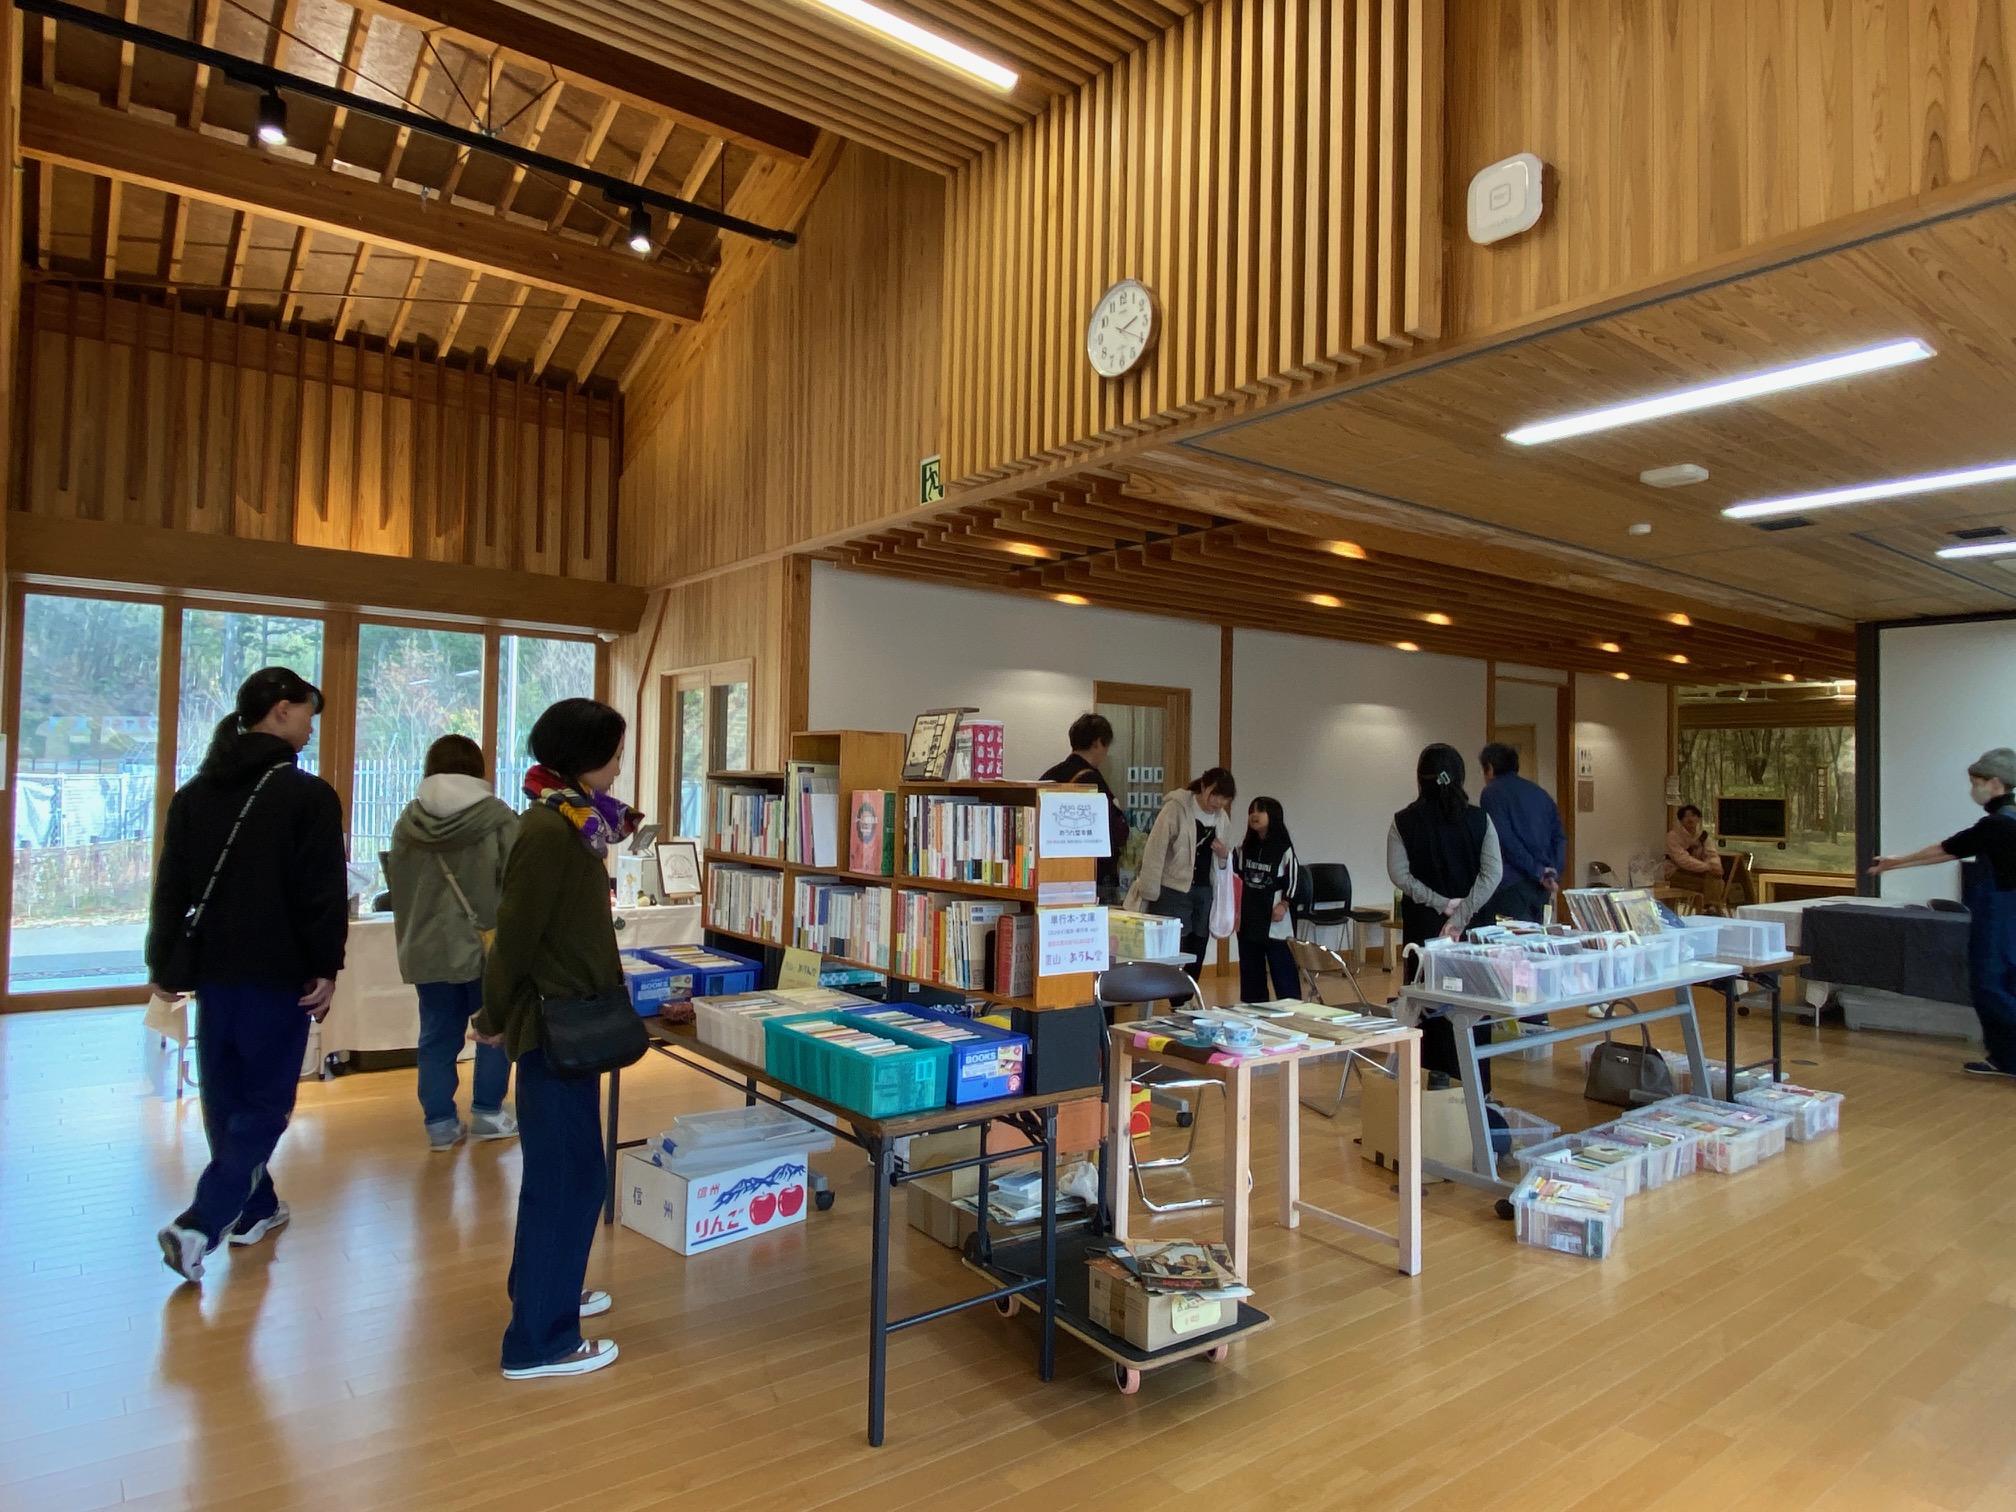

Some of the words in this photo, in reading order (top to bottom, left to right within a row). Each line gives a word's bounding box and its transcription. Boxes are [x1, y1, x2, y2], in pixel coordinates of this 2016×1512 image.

[1050, 912, 1096, 925] 単行本・文庫
[641, 980, 669, 991] BOOKS
[965, 1051, 997, 1064] BOOKS
[696, 1183, 720, 1200] 信州
[695, 1208, 745, 1239] りんご
